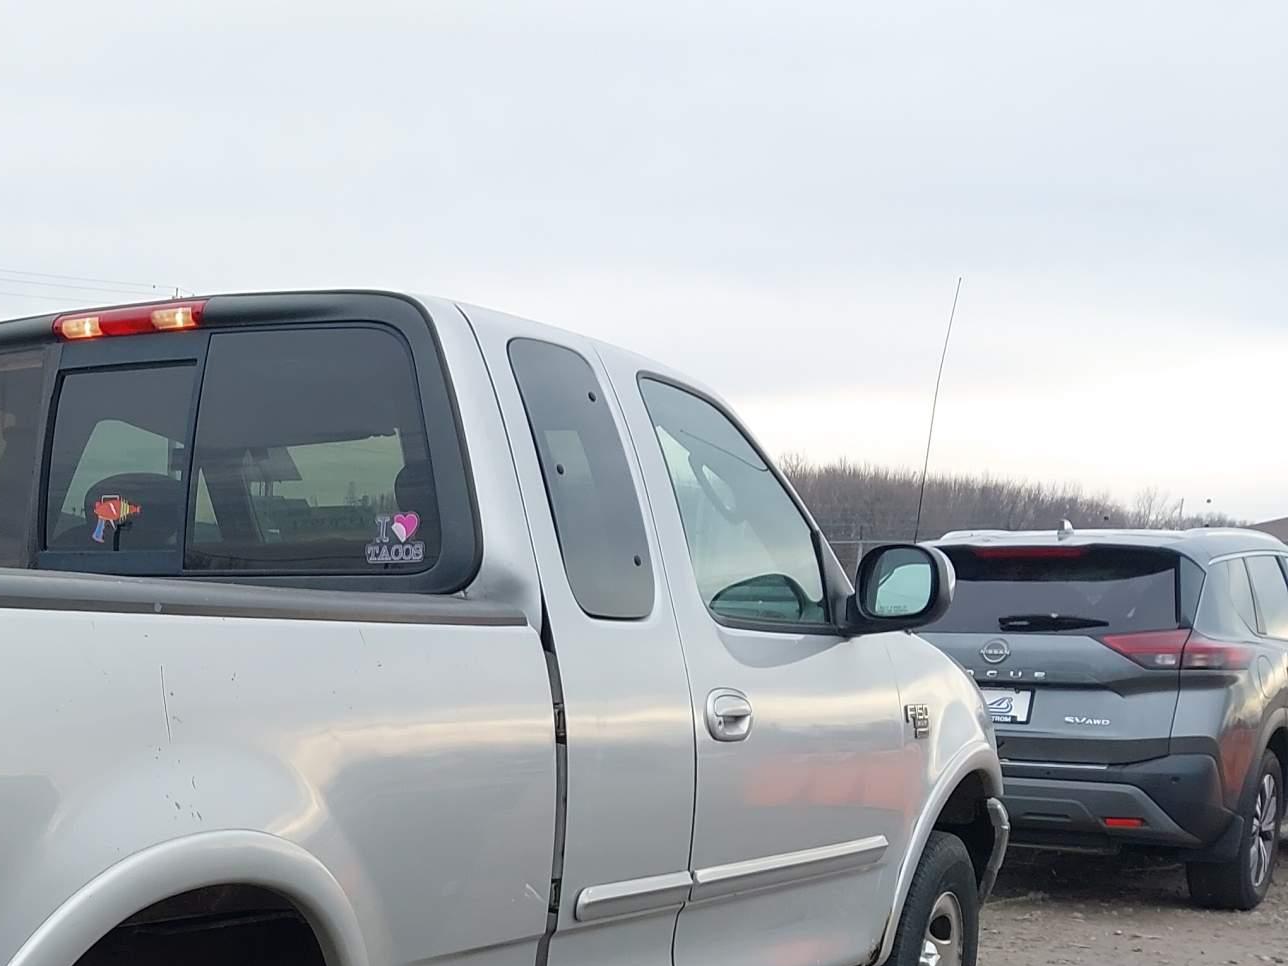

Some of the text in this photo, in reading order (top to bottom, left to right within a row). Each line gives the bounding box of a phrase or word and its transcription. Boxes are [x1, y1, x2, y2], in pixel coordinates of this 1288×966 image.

[375, 515, 391, 543] I
[367, 543, 423, 562] TACOS
[979, 648, 1011, 656] NISSAN
